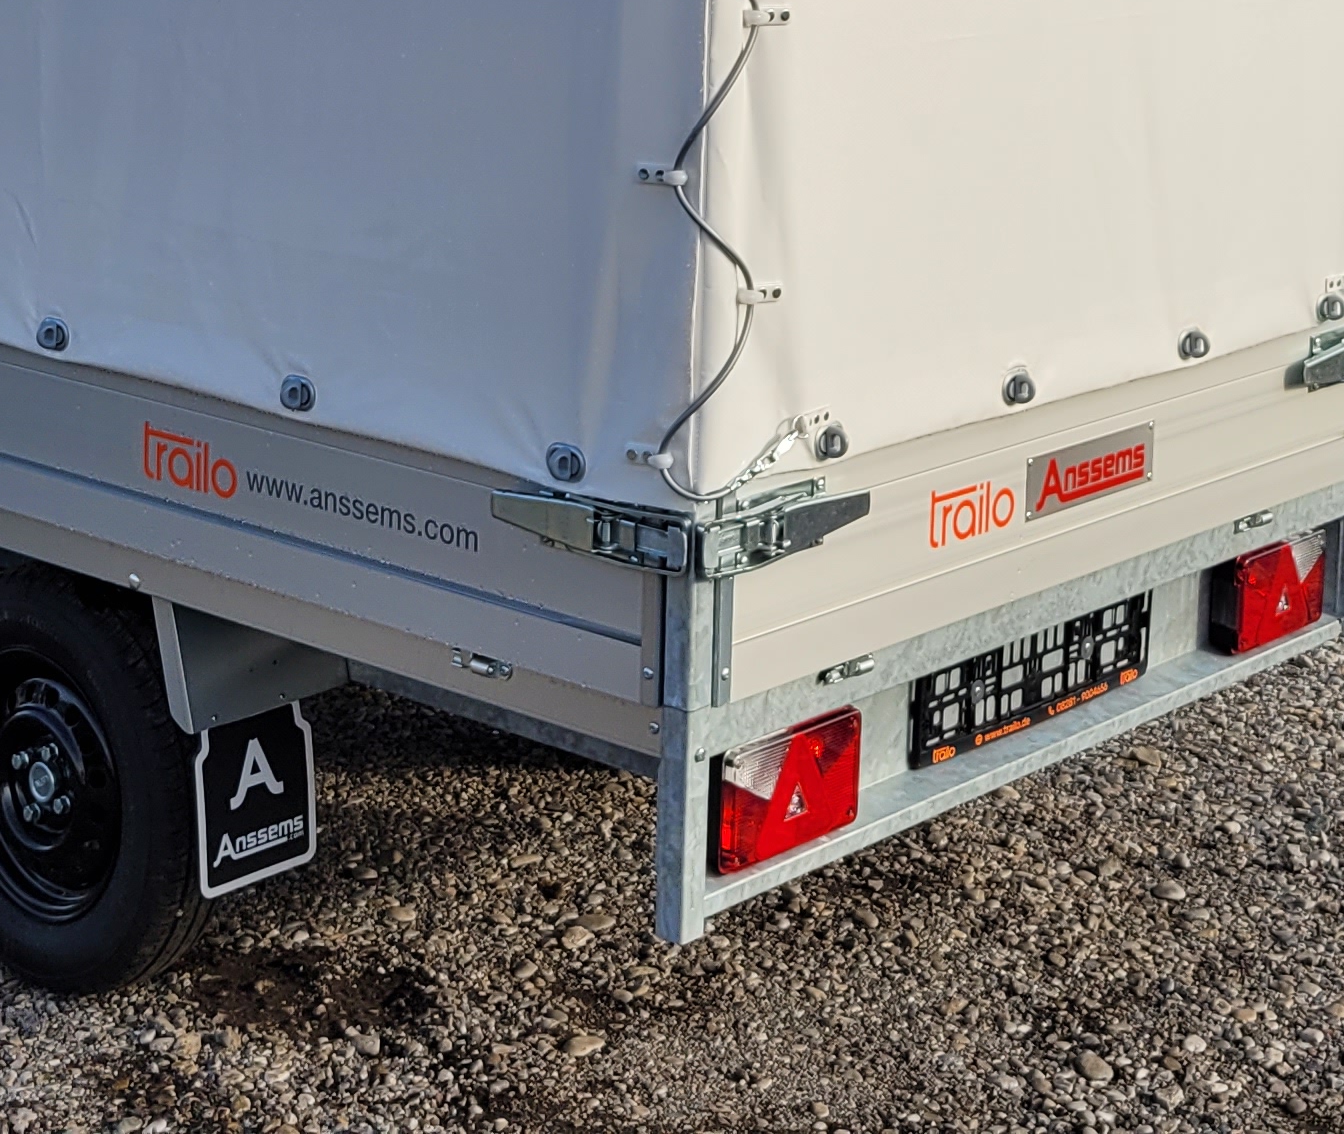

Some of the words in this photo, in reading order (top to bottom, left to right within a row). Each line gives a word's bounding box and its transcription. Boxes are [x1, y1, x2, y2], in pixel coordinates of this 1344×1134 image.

[143, 420, 238, 499] trailo
[245, 468, 479, 553] www.anssems.com
[1036, 442, 1146, 512] Anssems
[929, 481, 1015, 548] trailo
[213, 815, 304, 868] Anssems
